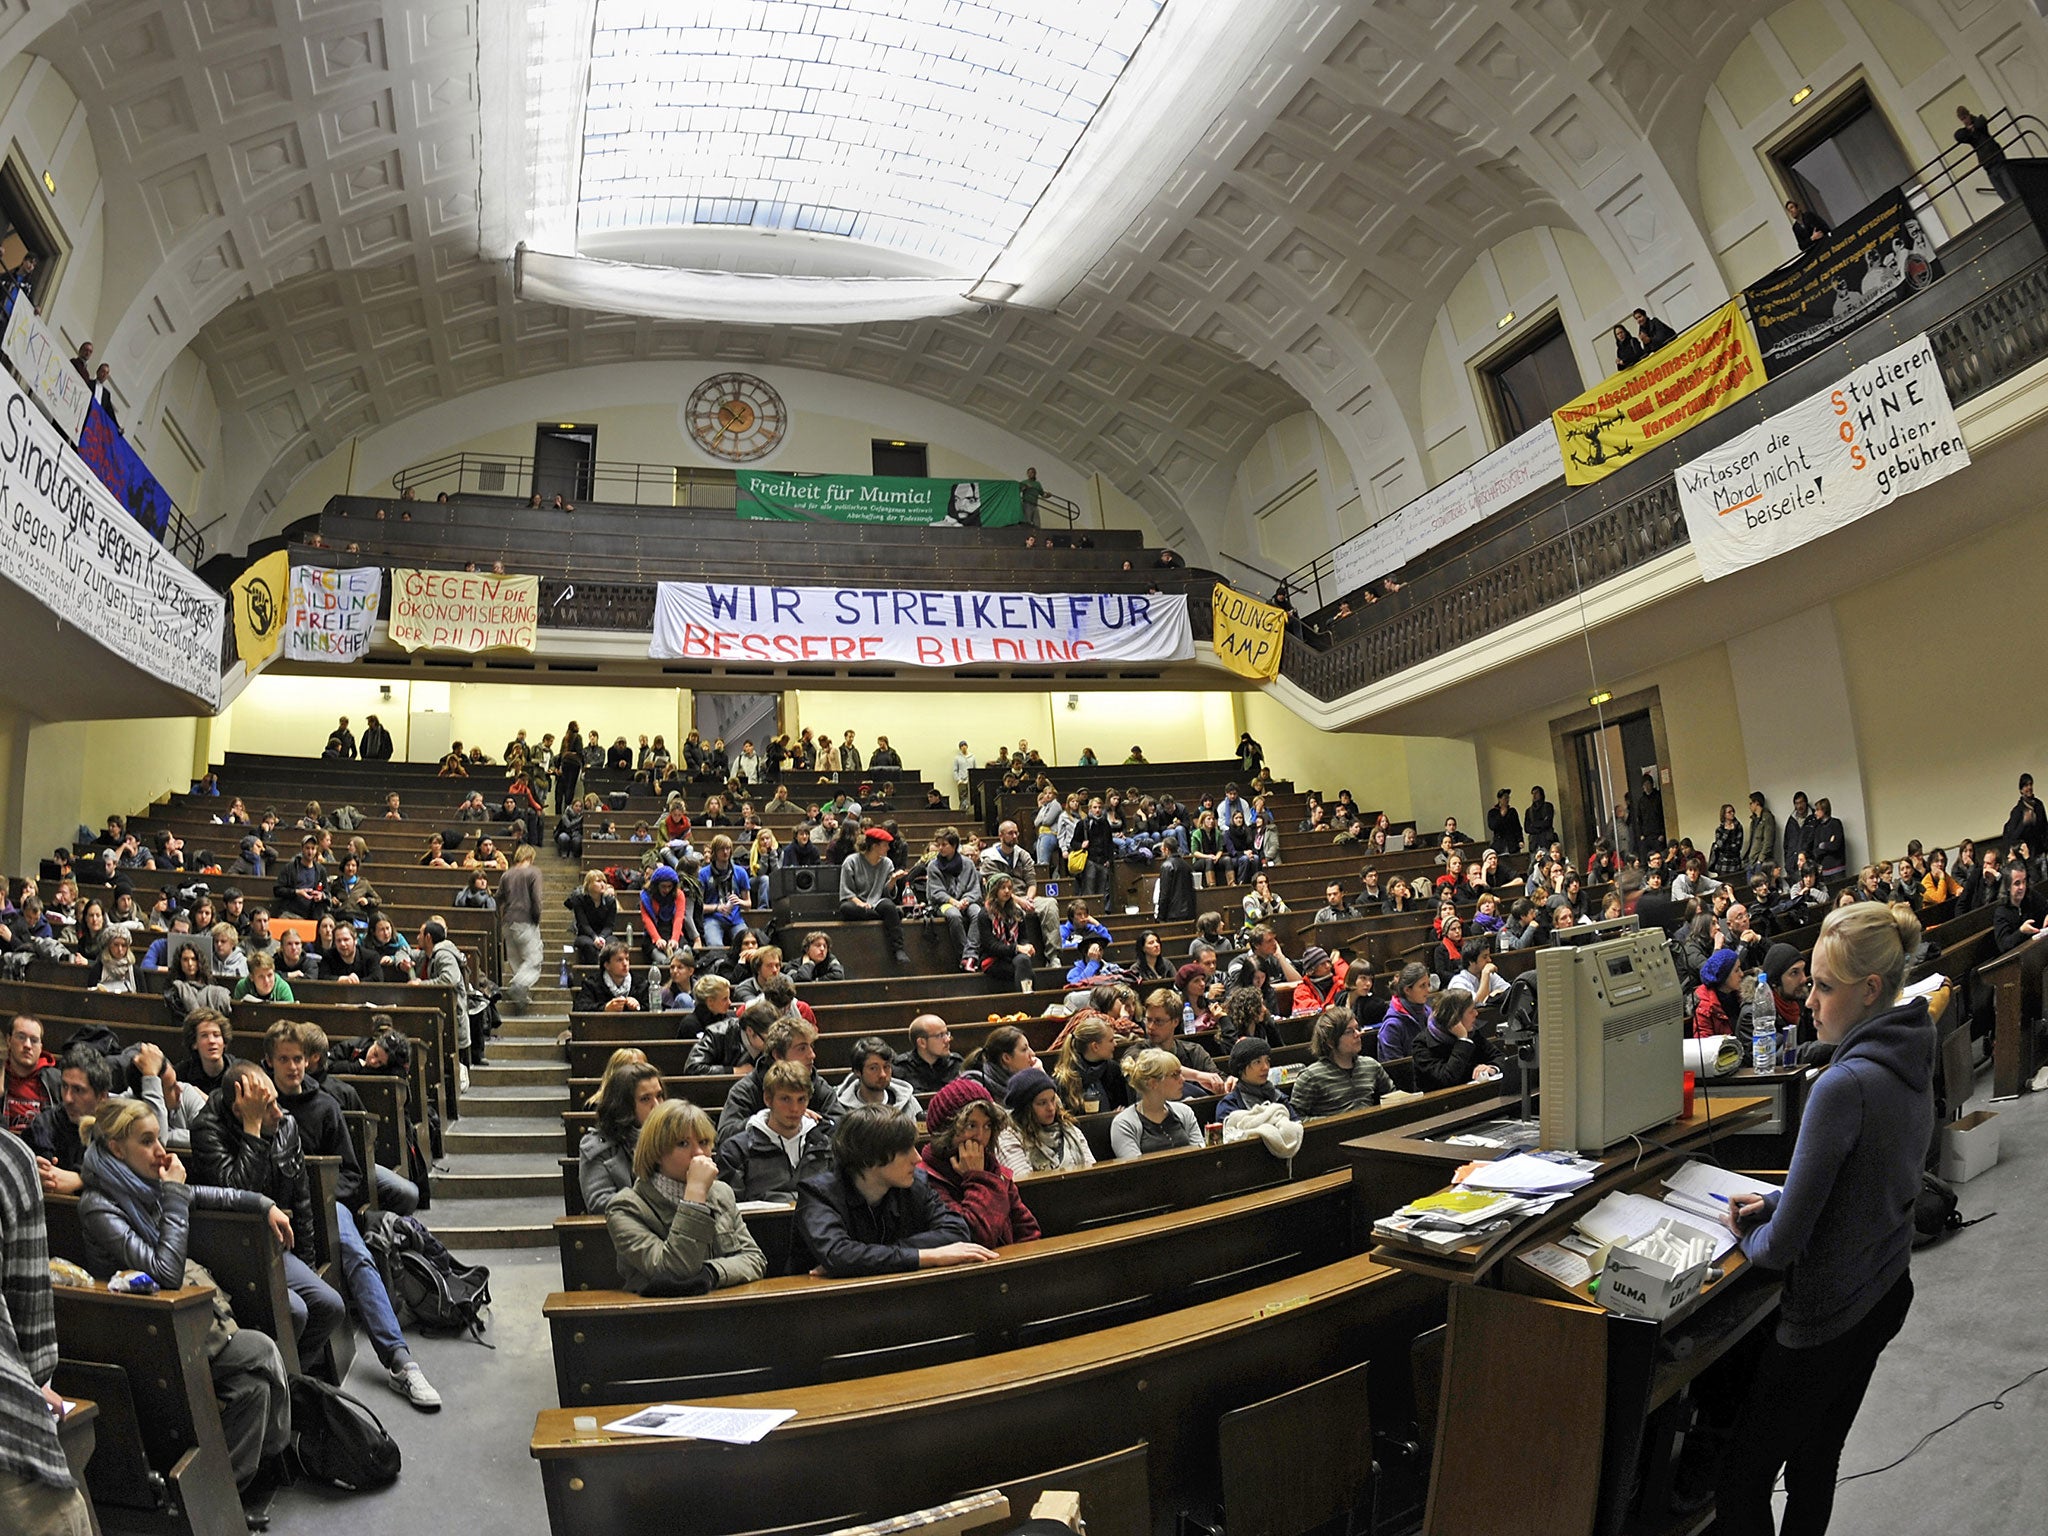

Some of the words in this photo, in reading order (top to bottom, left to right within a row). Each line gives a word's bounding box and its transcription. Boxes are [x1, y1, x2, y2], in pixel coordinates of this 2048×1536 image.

[1830, 348, 1933, 416] Studieren
[1627, 395, 1655, 422] und
[1839, 380, 1923, 443] OHNE
[1682, 473, 1708, 494] Wir
[1710, 451, 1760, 484] lassen
[1767, 434, 1790, 454] die
[1850, 420, 1936, 471] Studien-
[1713, 473, 1762, 512] Moral
[1764, 446, 1811, 490] nicht
[1877, 437, 1963, 495] gebühren
[1, 393, 95, 537] Sinologie
[98, 517, 142, 583] gegen
[749, 477, 821, 499] Freiheit
[823, 484, 855, 504] für
[859, 486, 932, 504] Mumia!
[1745, 476, 1825, 529] beiseite!
[847, 513, 884, 522] Abschaffung
[899, 515, 934, 523] Todesstrafe
[870, 505, 906, 513] Gefangenen
[0, 527, 77, 601] uchwissenschaft
[96, 600, 122, 629] Physik
[12, 502, 57, 556] gegen
[59, 524, 132, 613] Kürzungen
[130, 584, 147, 627] bei
[149, 602, 199, 661] Soziologie
[300, 568, 368, 593] FREIE
[405, 573, 502, 601] GEGEN
[504, 589, 528, 603] DIE
[293, 587, 378, 612] BILDUNG
[397, 597, 537, 625] ÖKONOMISIERUNG
[705, 585, 803, 624] WIR
[834, 590, 1056, 630] STREIKEN
[1069, 592, 1153, 630] FÜR
[293, 625, 372, 655] MENSCHEN
[295, 610, 361, 631] FREIE
[395, 625, 423, 641] DER
[432, 626, 533, 649] BILDUNG
[682, 622, 884, 661] BESSERE
[916, 635, 1097, 665] BILDUNG
[1219, 626, 1269, 665] AMP
[1613, 1281, 1647, 1304] ULMA
